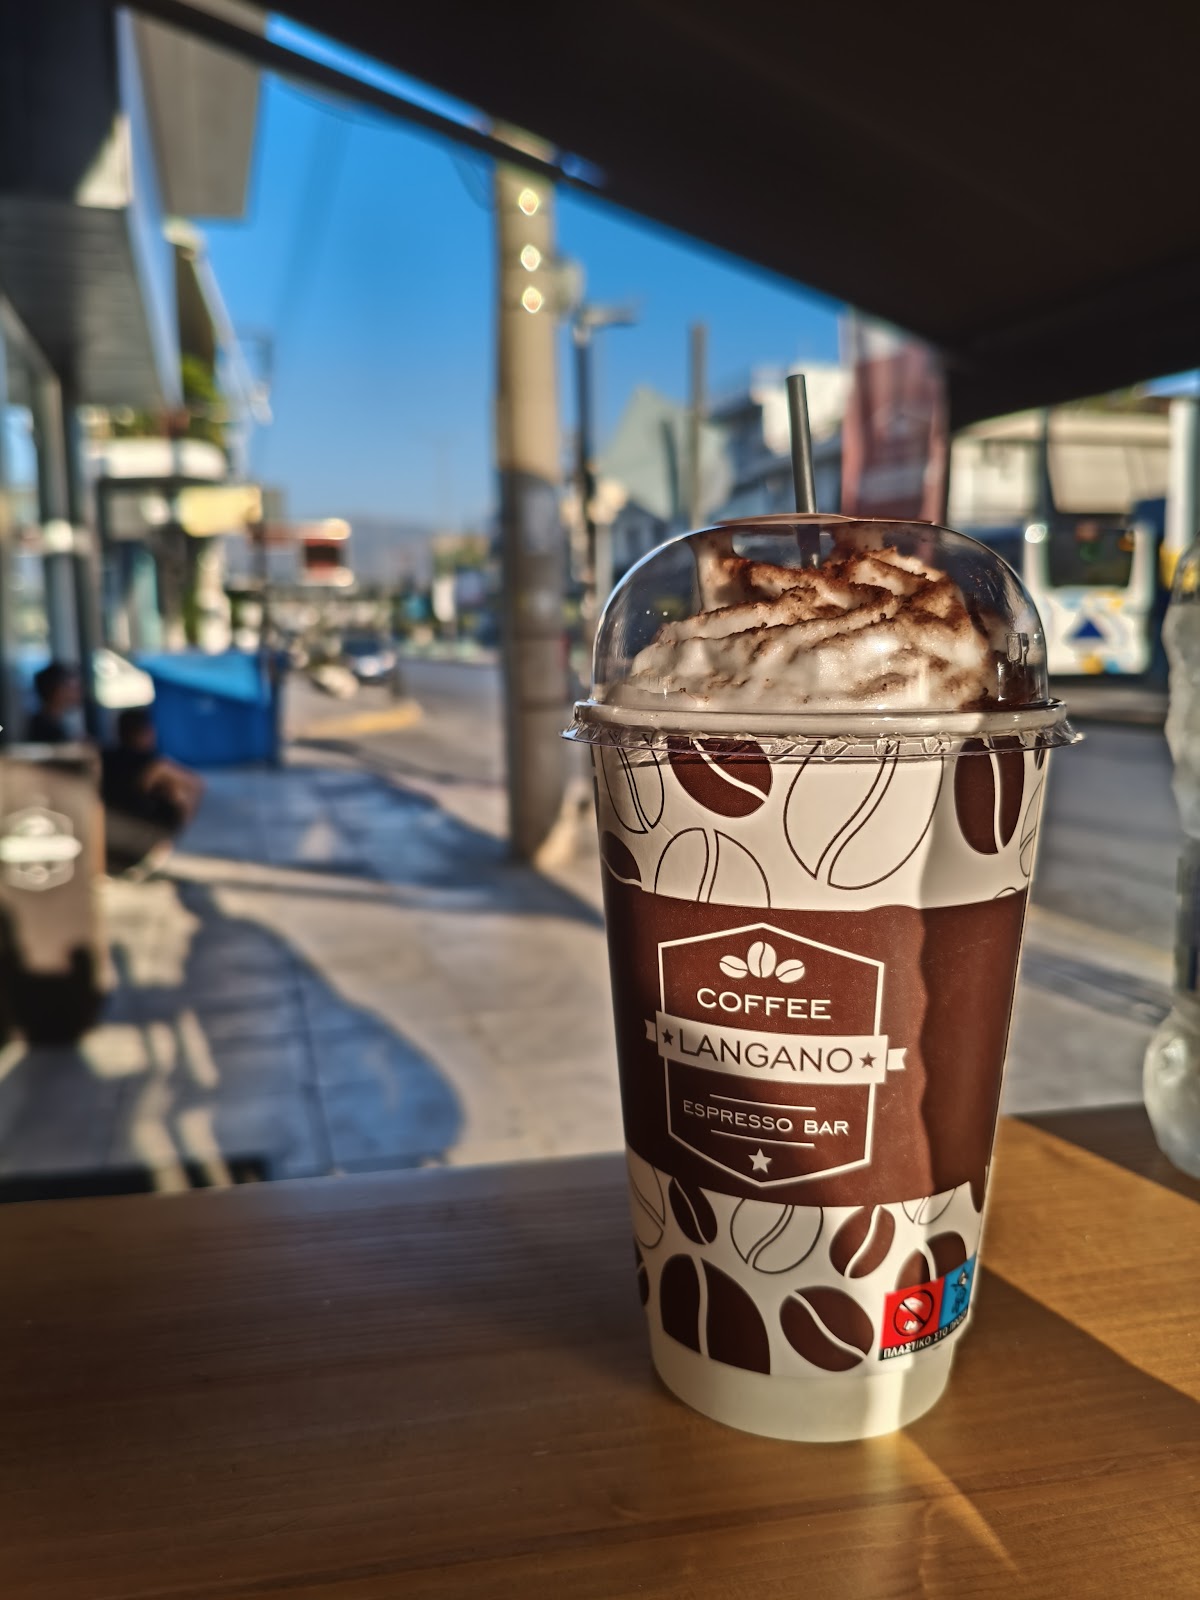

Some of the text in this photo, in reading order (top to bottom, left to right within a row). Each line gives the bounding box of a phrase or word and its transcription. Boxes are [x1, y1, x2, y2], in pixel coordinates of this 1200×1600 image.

[696, 987, 832, 1020] COFFEE
[678, 1028, 853, 1074] LANGANO
[683, 1099, 849, 1136] ESPRESSO BAR
[883, 1328, 948, 1358] ΠΛΑΣΤΙΚΟ ΣΤΟ
